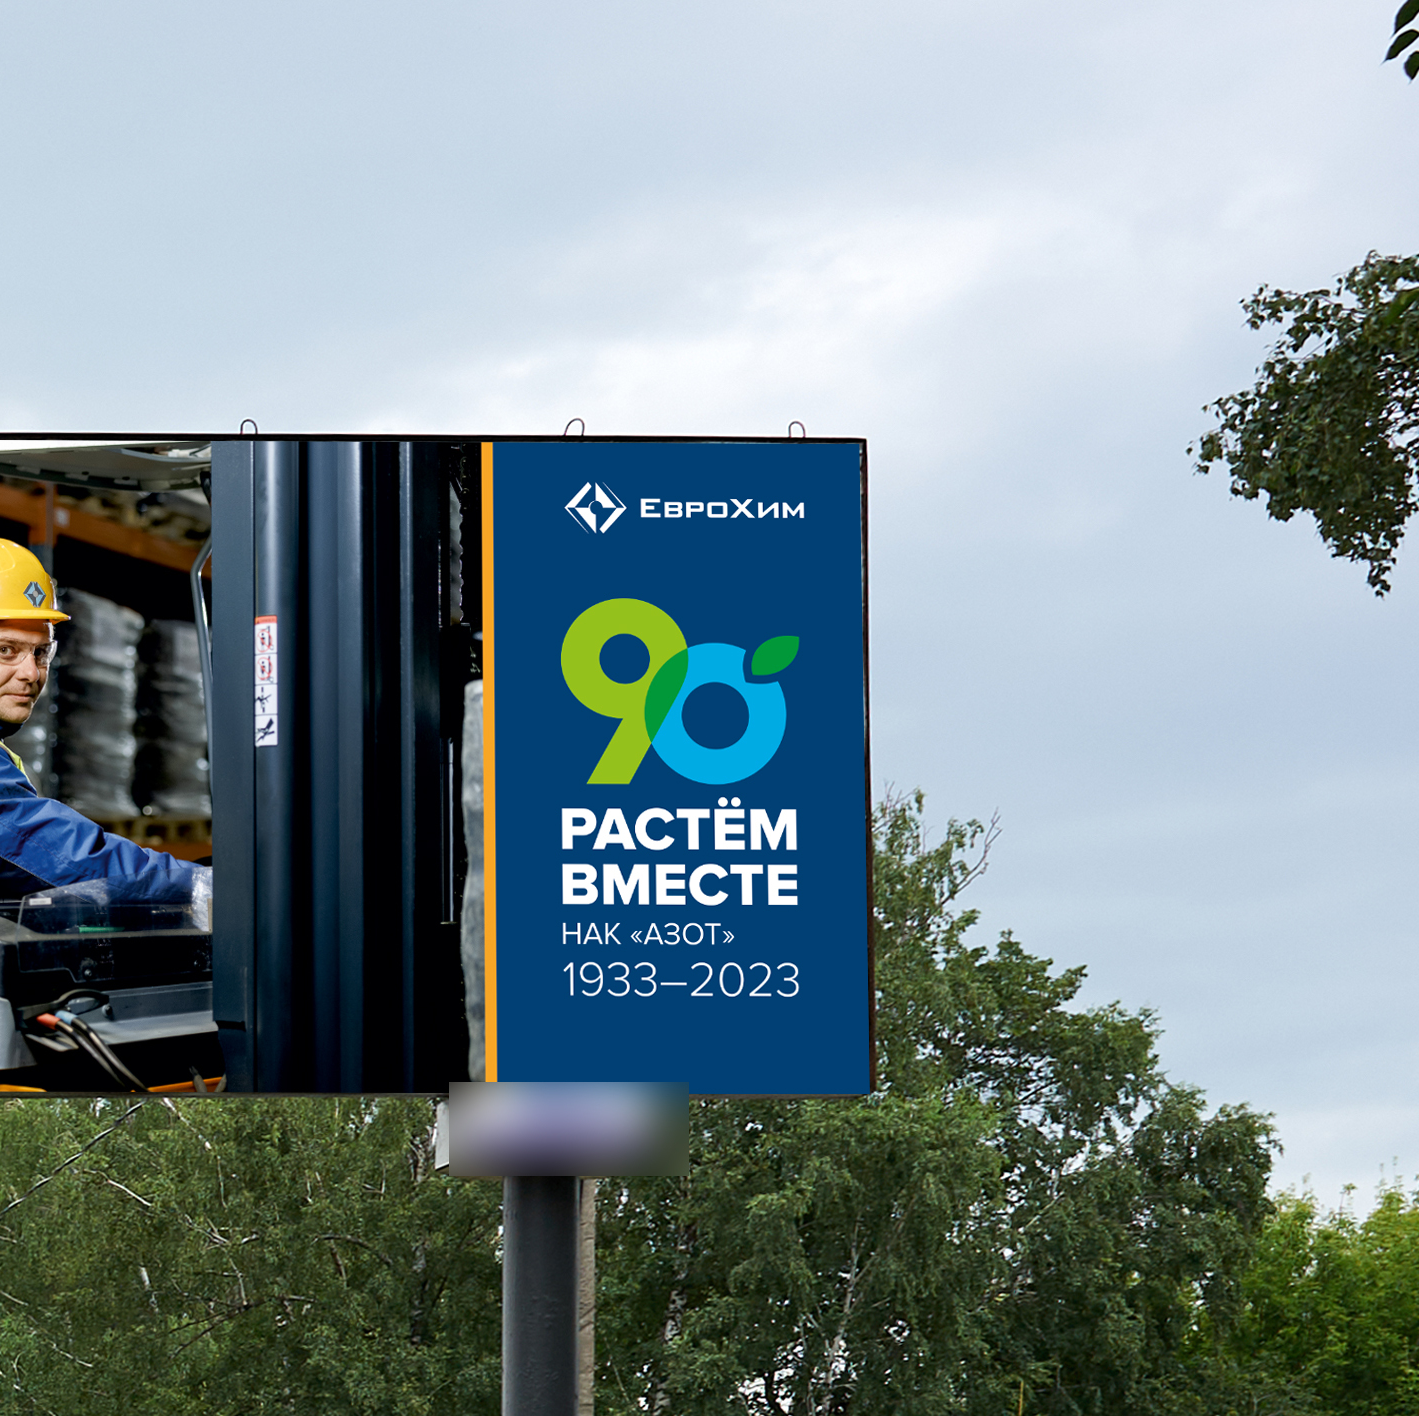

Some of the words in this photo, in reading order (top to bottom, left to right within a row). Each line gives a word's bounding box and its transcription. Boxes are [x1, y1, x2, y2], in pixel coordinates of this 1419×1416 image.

[561, 598, 787, 785] 90
[560, 797, 798, 851] РАСТЁМ
[560, 863, 799, 907] ВМЕСТЕ
[563, 922, 621, 945] НАК
[630, 922, 735, 946] «АЗОТ»
[563, 961, 799, 998] 1933–2023
